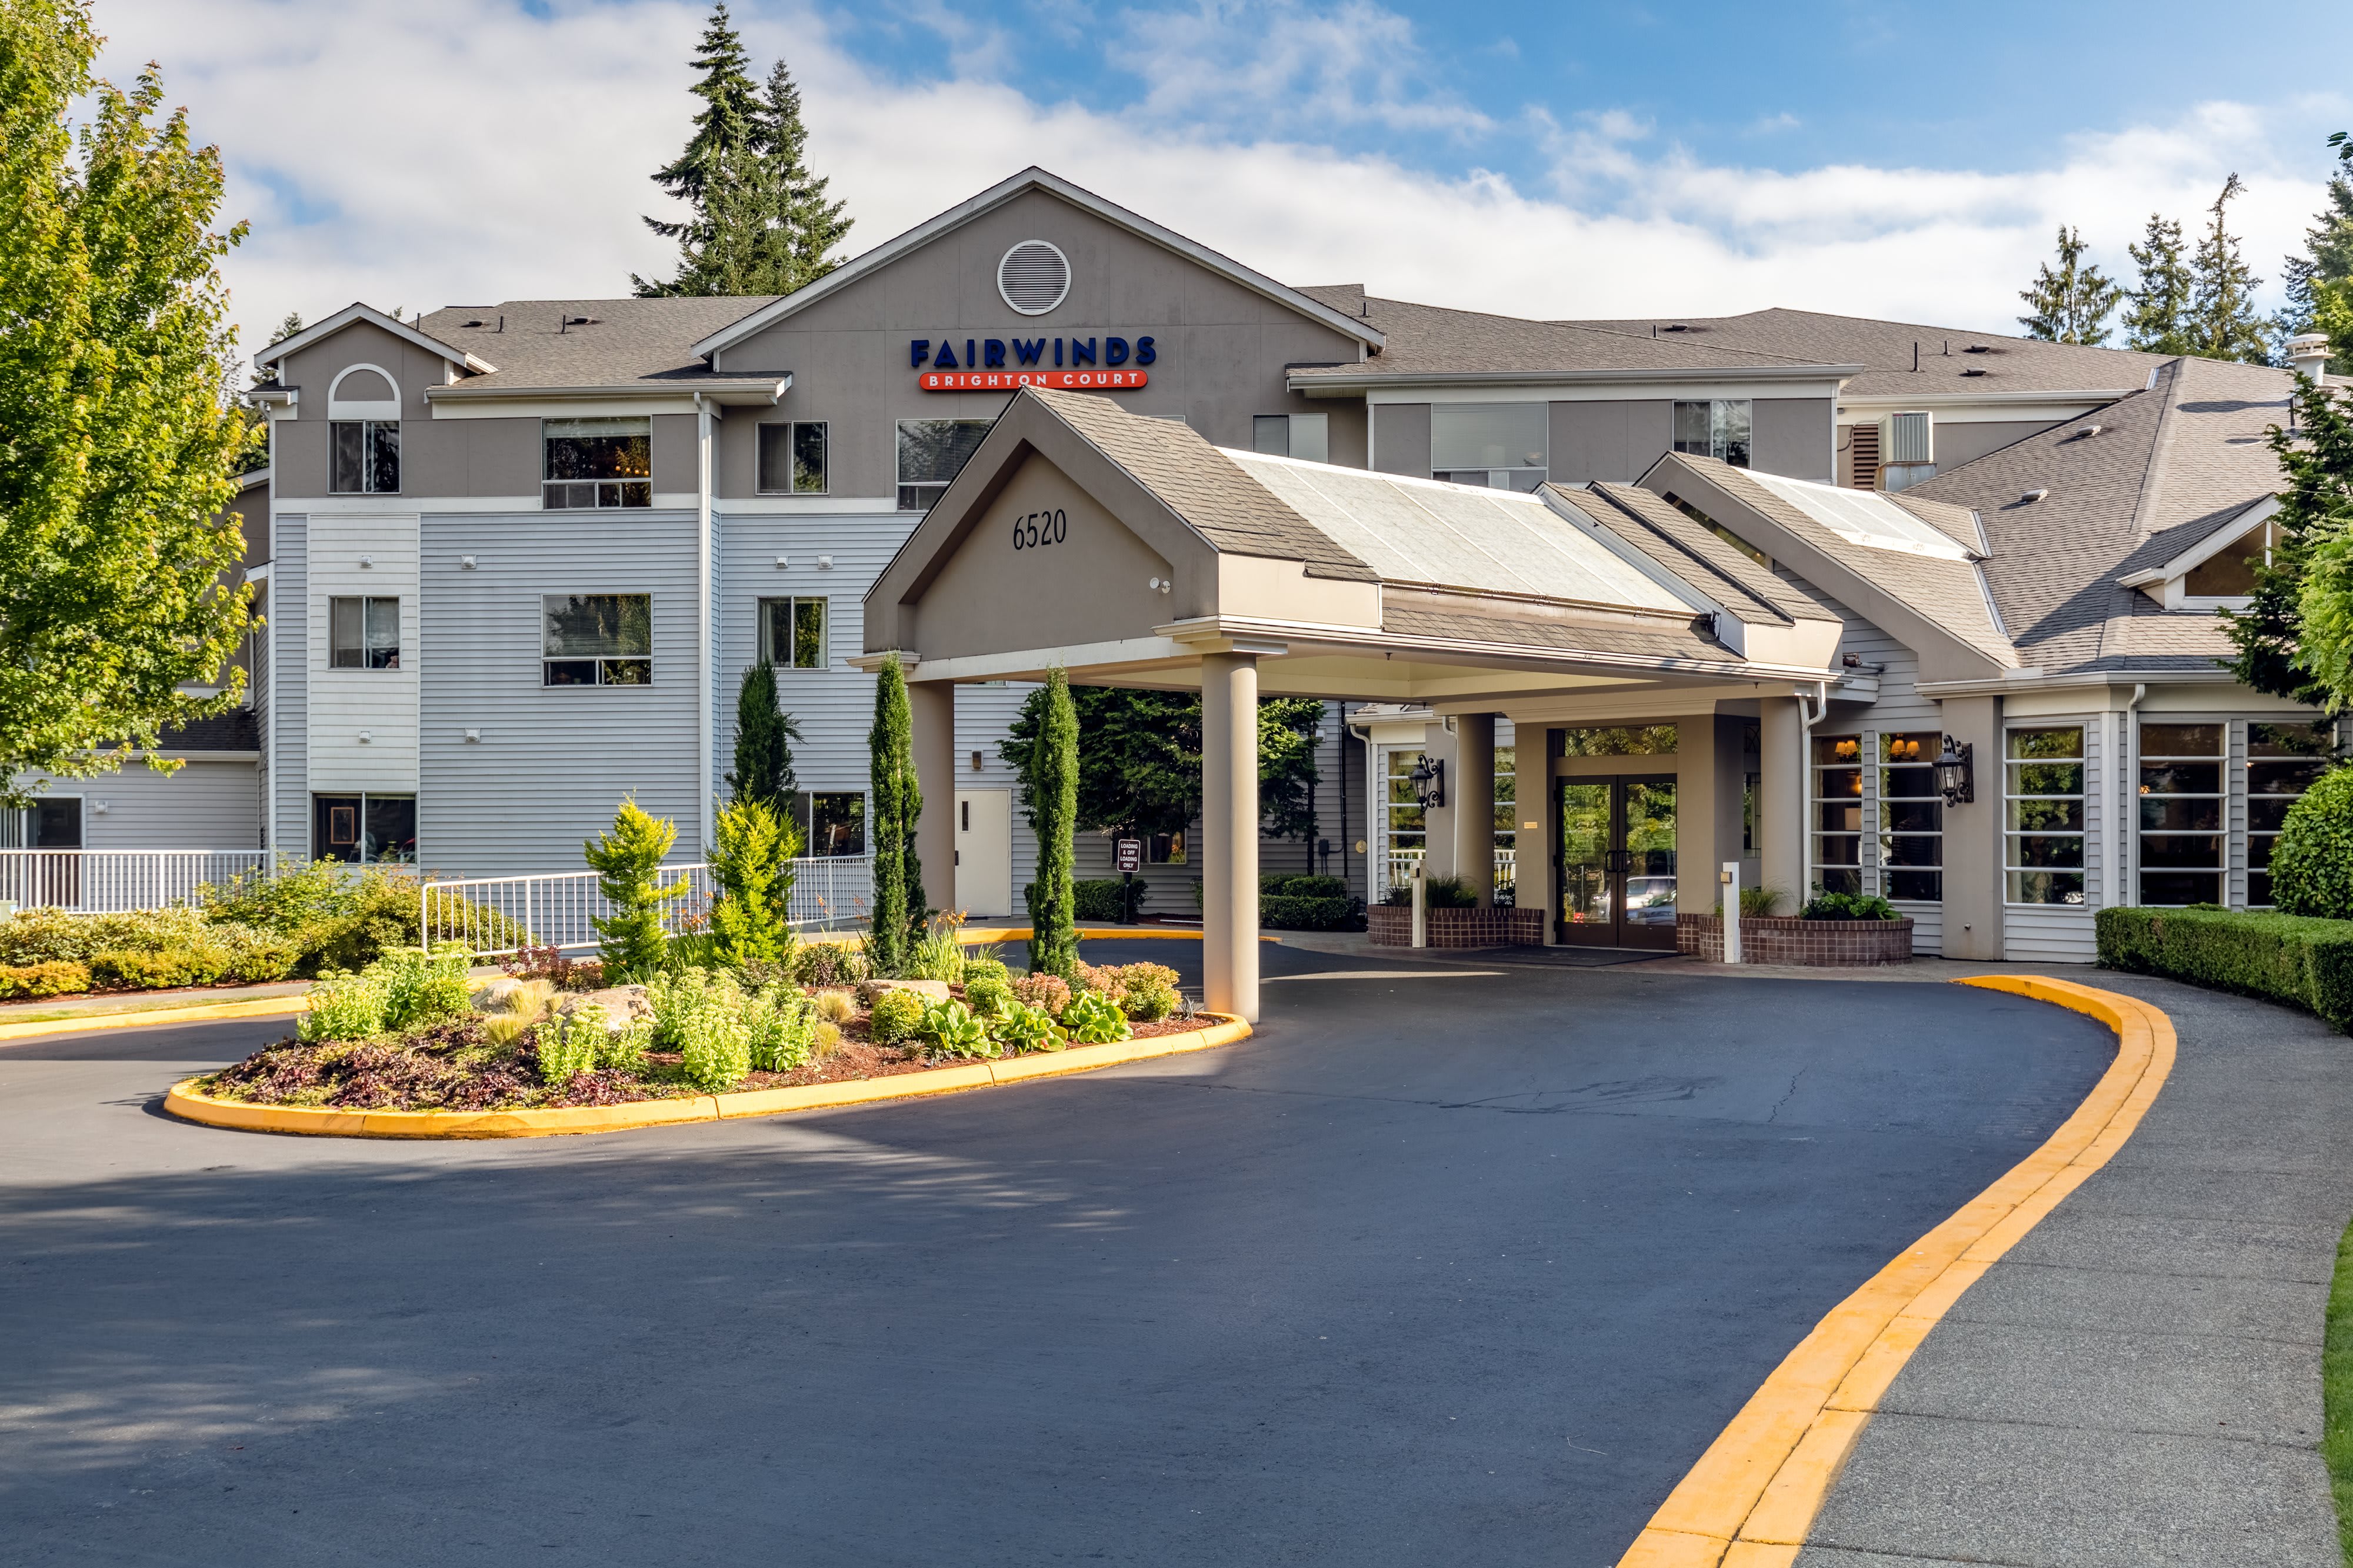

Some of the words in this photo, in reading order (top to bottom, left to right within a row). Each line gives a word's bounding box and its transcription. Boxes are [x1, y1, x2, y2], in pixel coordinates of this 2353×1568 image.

[911, 336, 1156, 367] FAIRWINDS
[929, 374, 1046, 386] BRIGHTON
[1063, 373, 1137, 385] COURT
[1014, 509, 1066, 550] 6520
